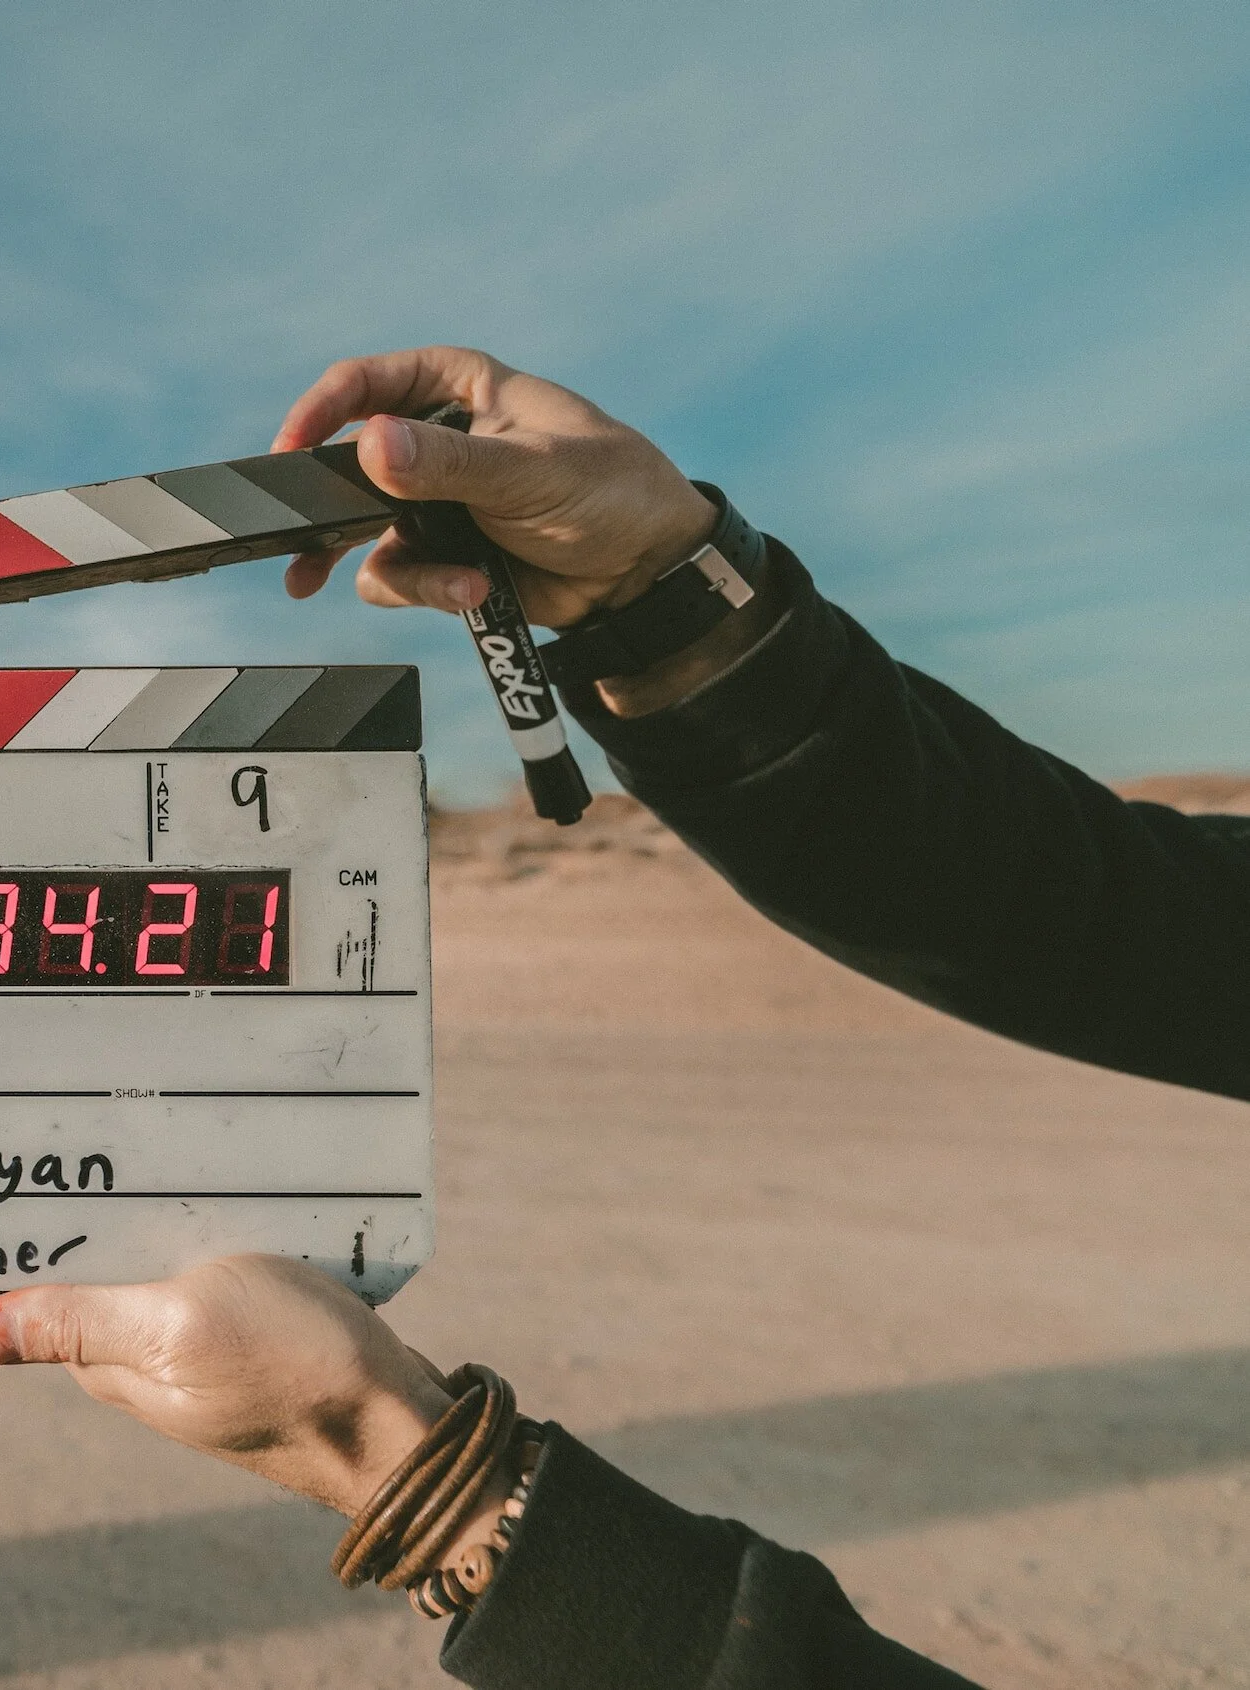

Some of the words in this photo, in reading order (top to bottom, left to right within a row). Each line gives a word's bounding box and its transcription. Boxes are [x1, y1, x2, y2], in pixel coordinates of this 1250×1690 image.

[480, 633, 545, 721] EXPO
[156, 763, 170, 833] TAKE
[230, 765, 271, 833] 9
[338, 869, 378, 887] CAM
[194, 989, 207, 999] DF
[115, 1088, 156, 1099] SHOW#
